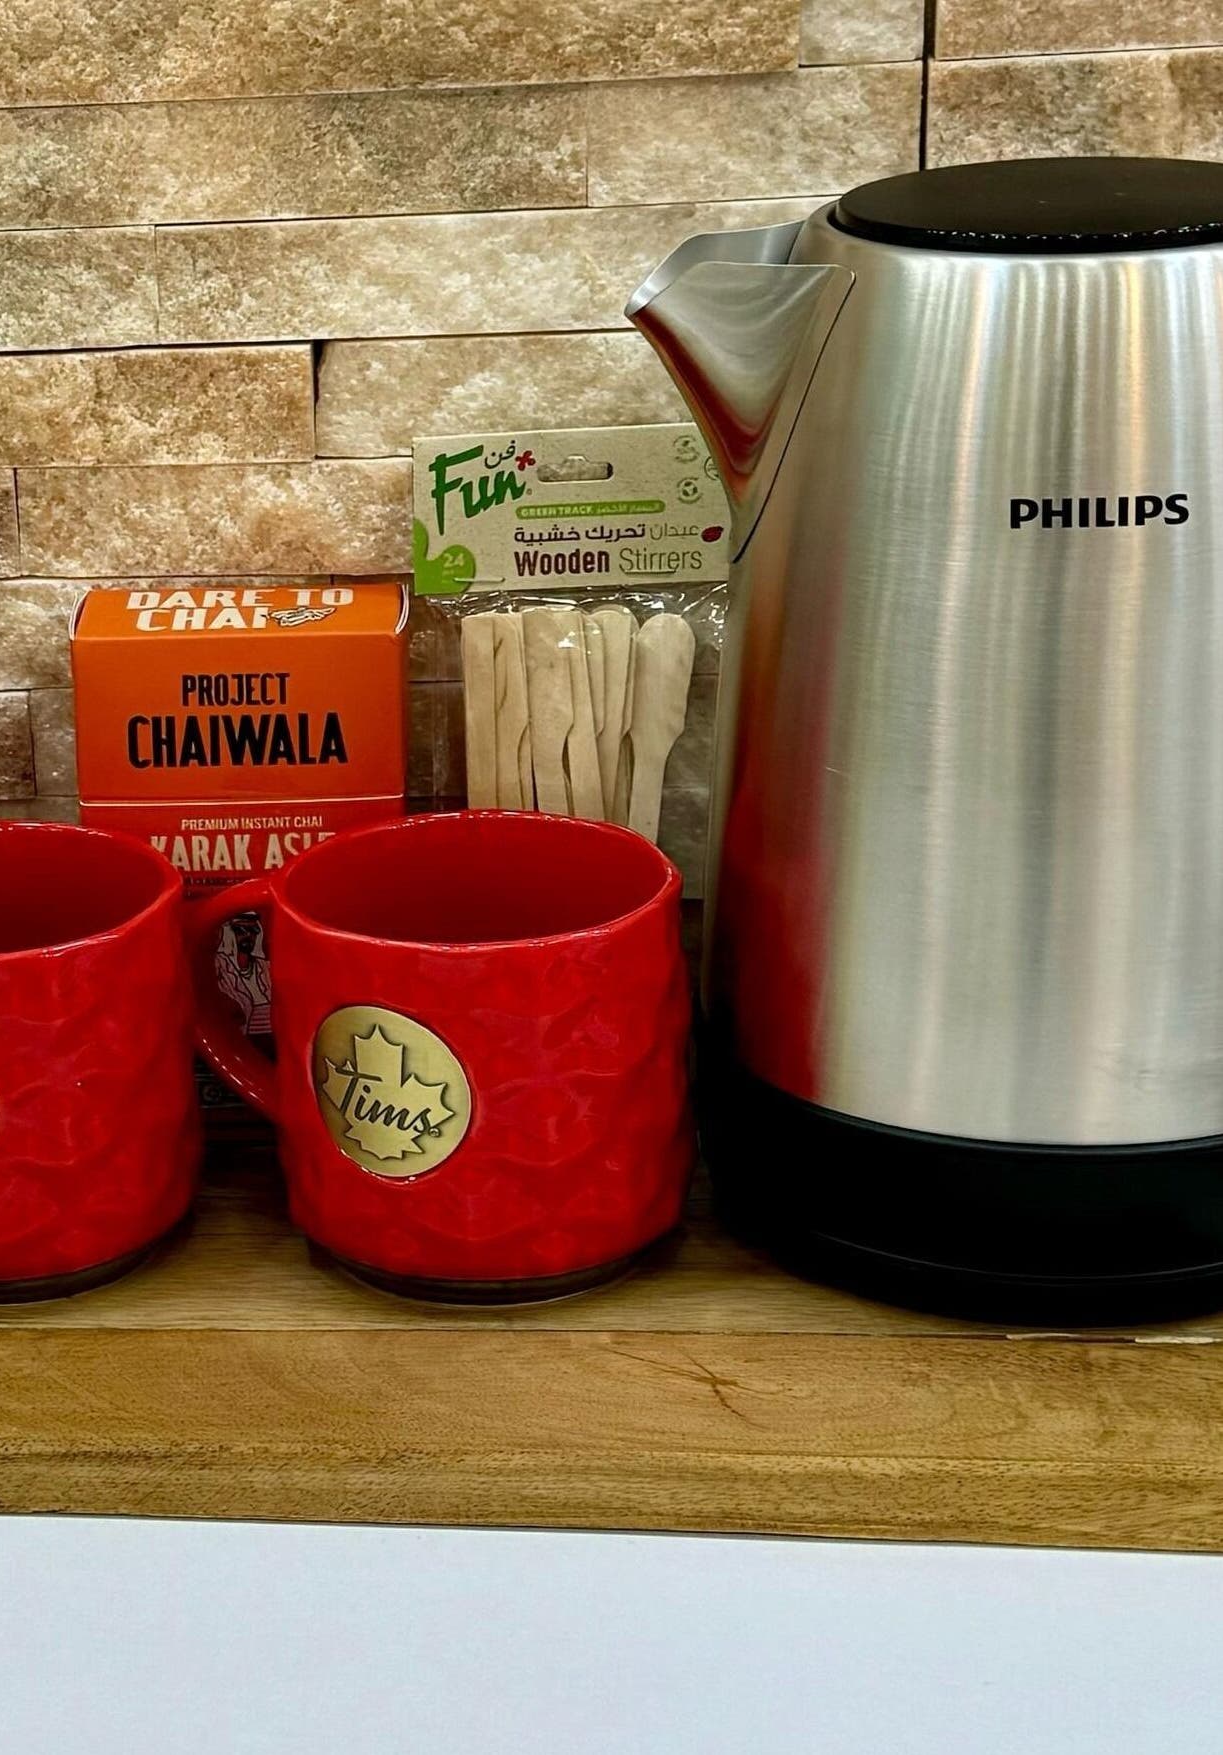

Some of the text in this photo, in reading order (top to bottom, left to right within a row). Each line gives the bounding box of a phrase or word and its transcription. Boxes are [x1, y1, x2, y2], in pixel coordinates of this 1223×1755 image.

[484, 439, 516, 469] فن
[428, 444, 527, 536] Fun
[521, 505, 593, 518] GREEN TRACK
[1009, 493, 1190, 529] PHILIPS
[513, 524, 582, 547] خشبية
[584, 523, 646, 543] تحريك
[442, 552, 465, 569] 24
[513, 547, 703, 577] Wooden Stirrers
[126, 587, 354, 609] DARE TO
[135, 606, 269, 632] CHAI
[181, 672, 291, 707] PROJECT
[127, 711, 349, 769] CHAIWALA
[180, 815, 323, 831] PREMIUM INSTANT CHAI
